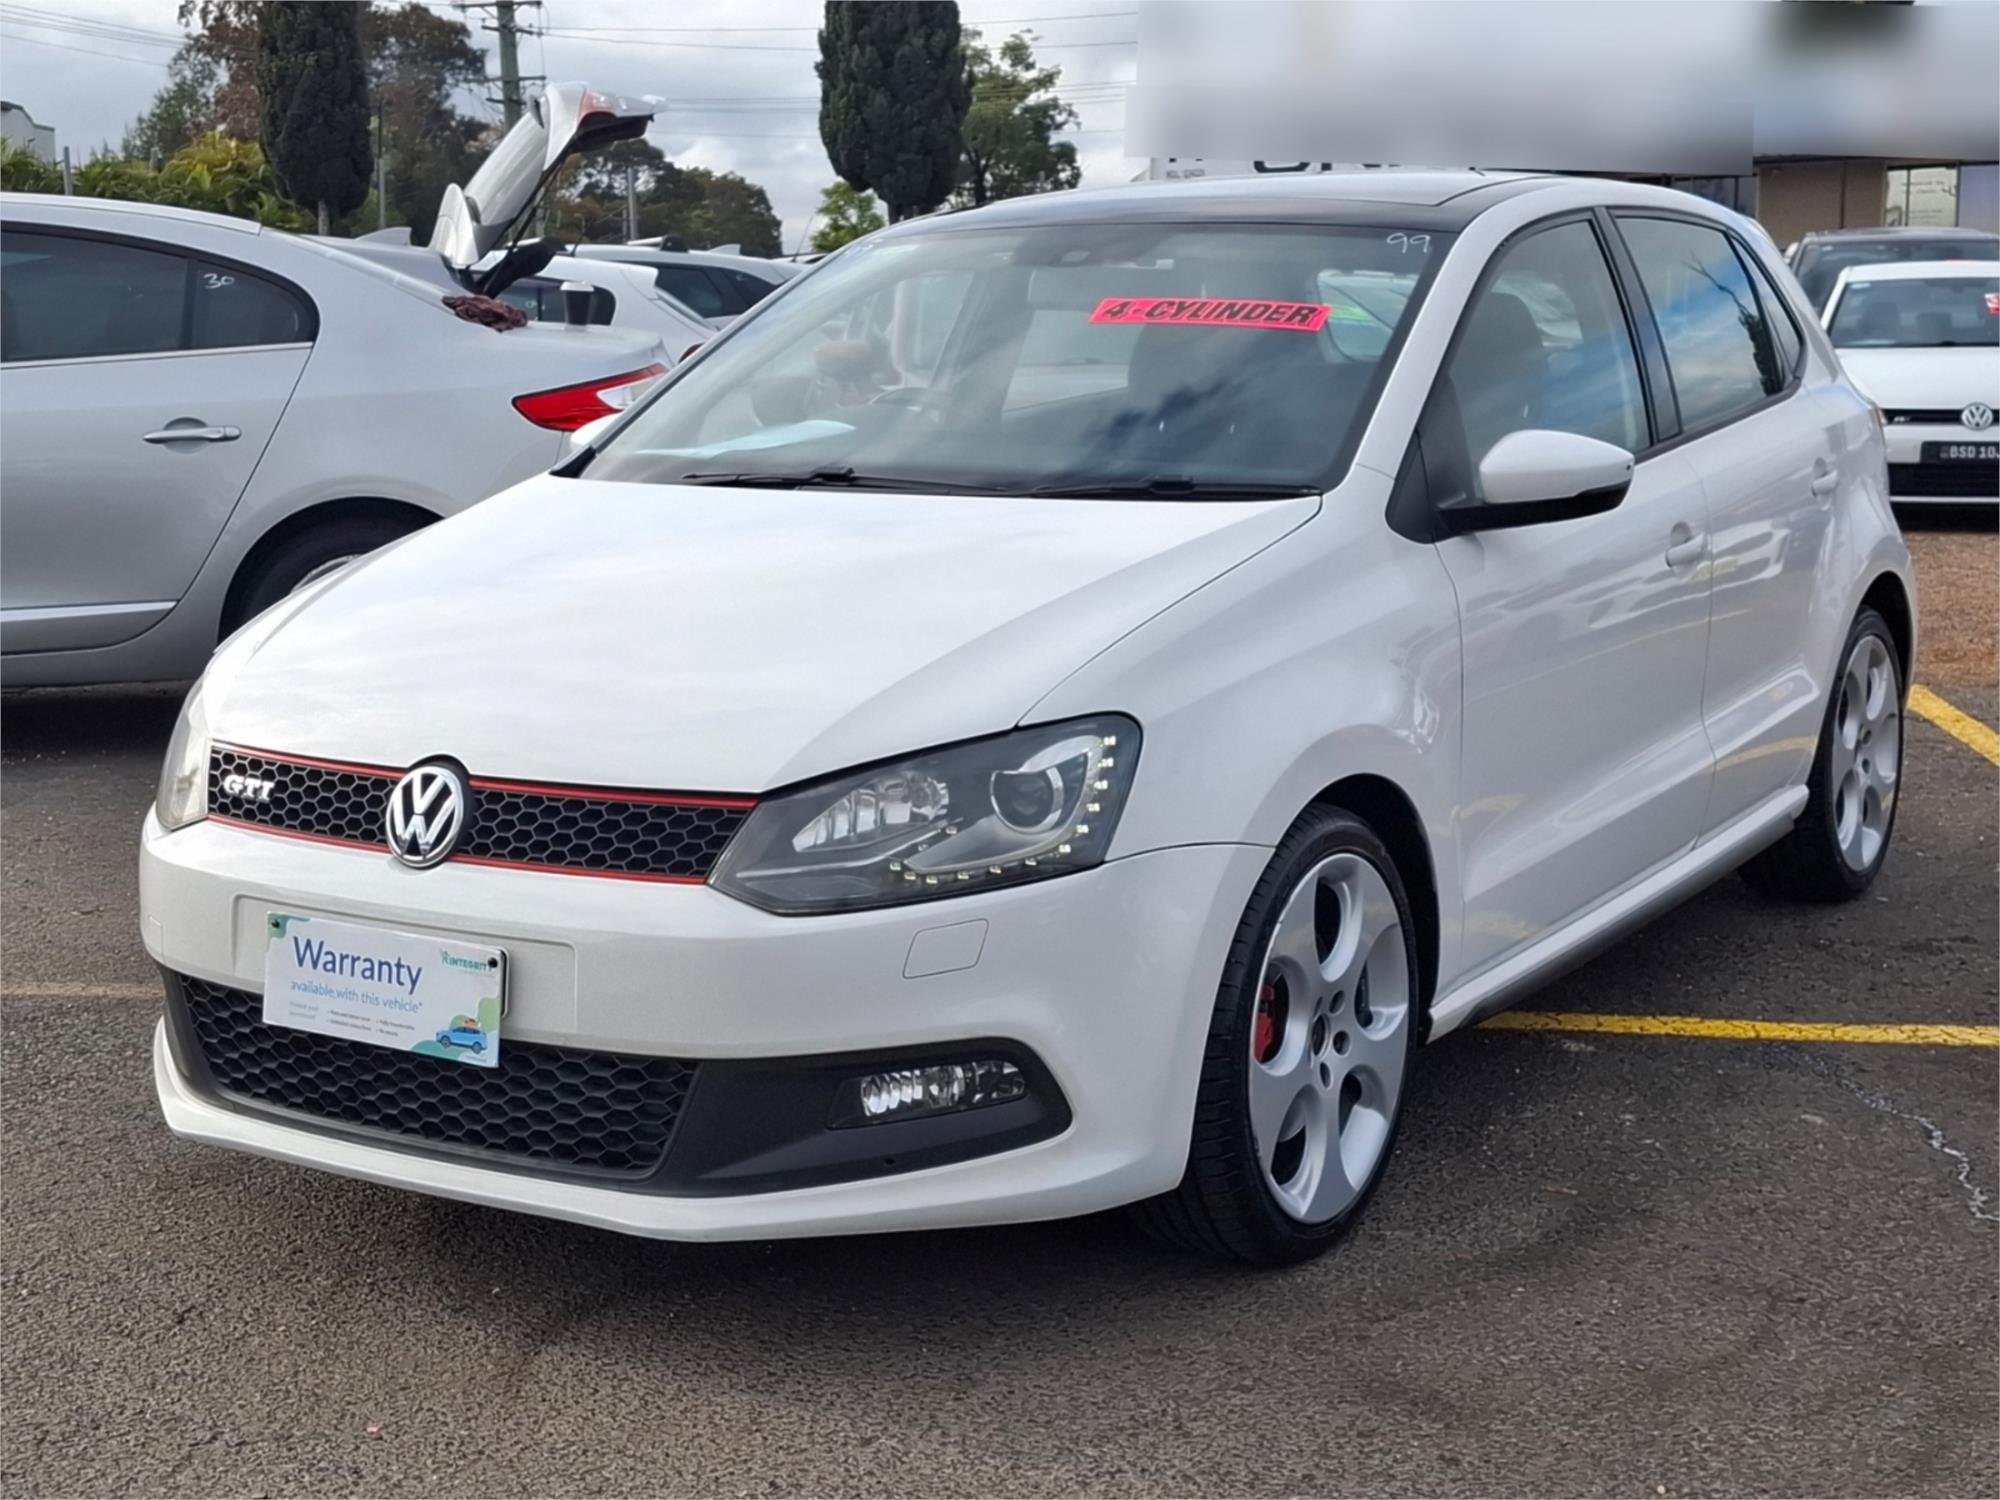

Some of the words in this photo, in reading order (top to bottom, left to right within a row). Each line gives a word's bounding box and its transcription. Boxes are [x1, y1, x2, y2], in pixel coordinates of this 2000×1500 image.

[1386, 232, 1431, 254] 99
[203, 272, 235, 289] 30
[1103, 300, 1321, 325] 4-CYLINDER
[222, 774, 275, 801] GTI
[293, 935, 423, 995] Warranty
[290, 980, 335, 998] available
[336, 986, 359, 1003] with
[361, 992, 380, 1006] this
